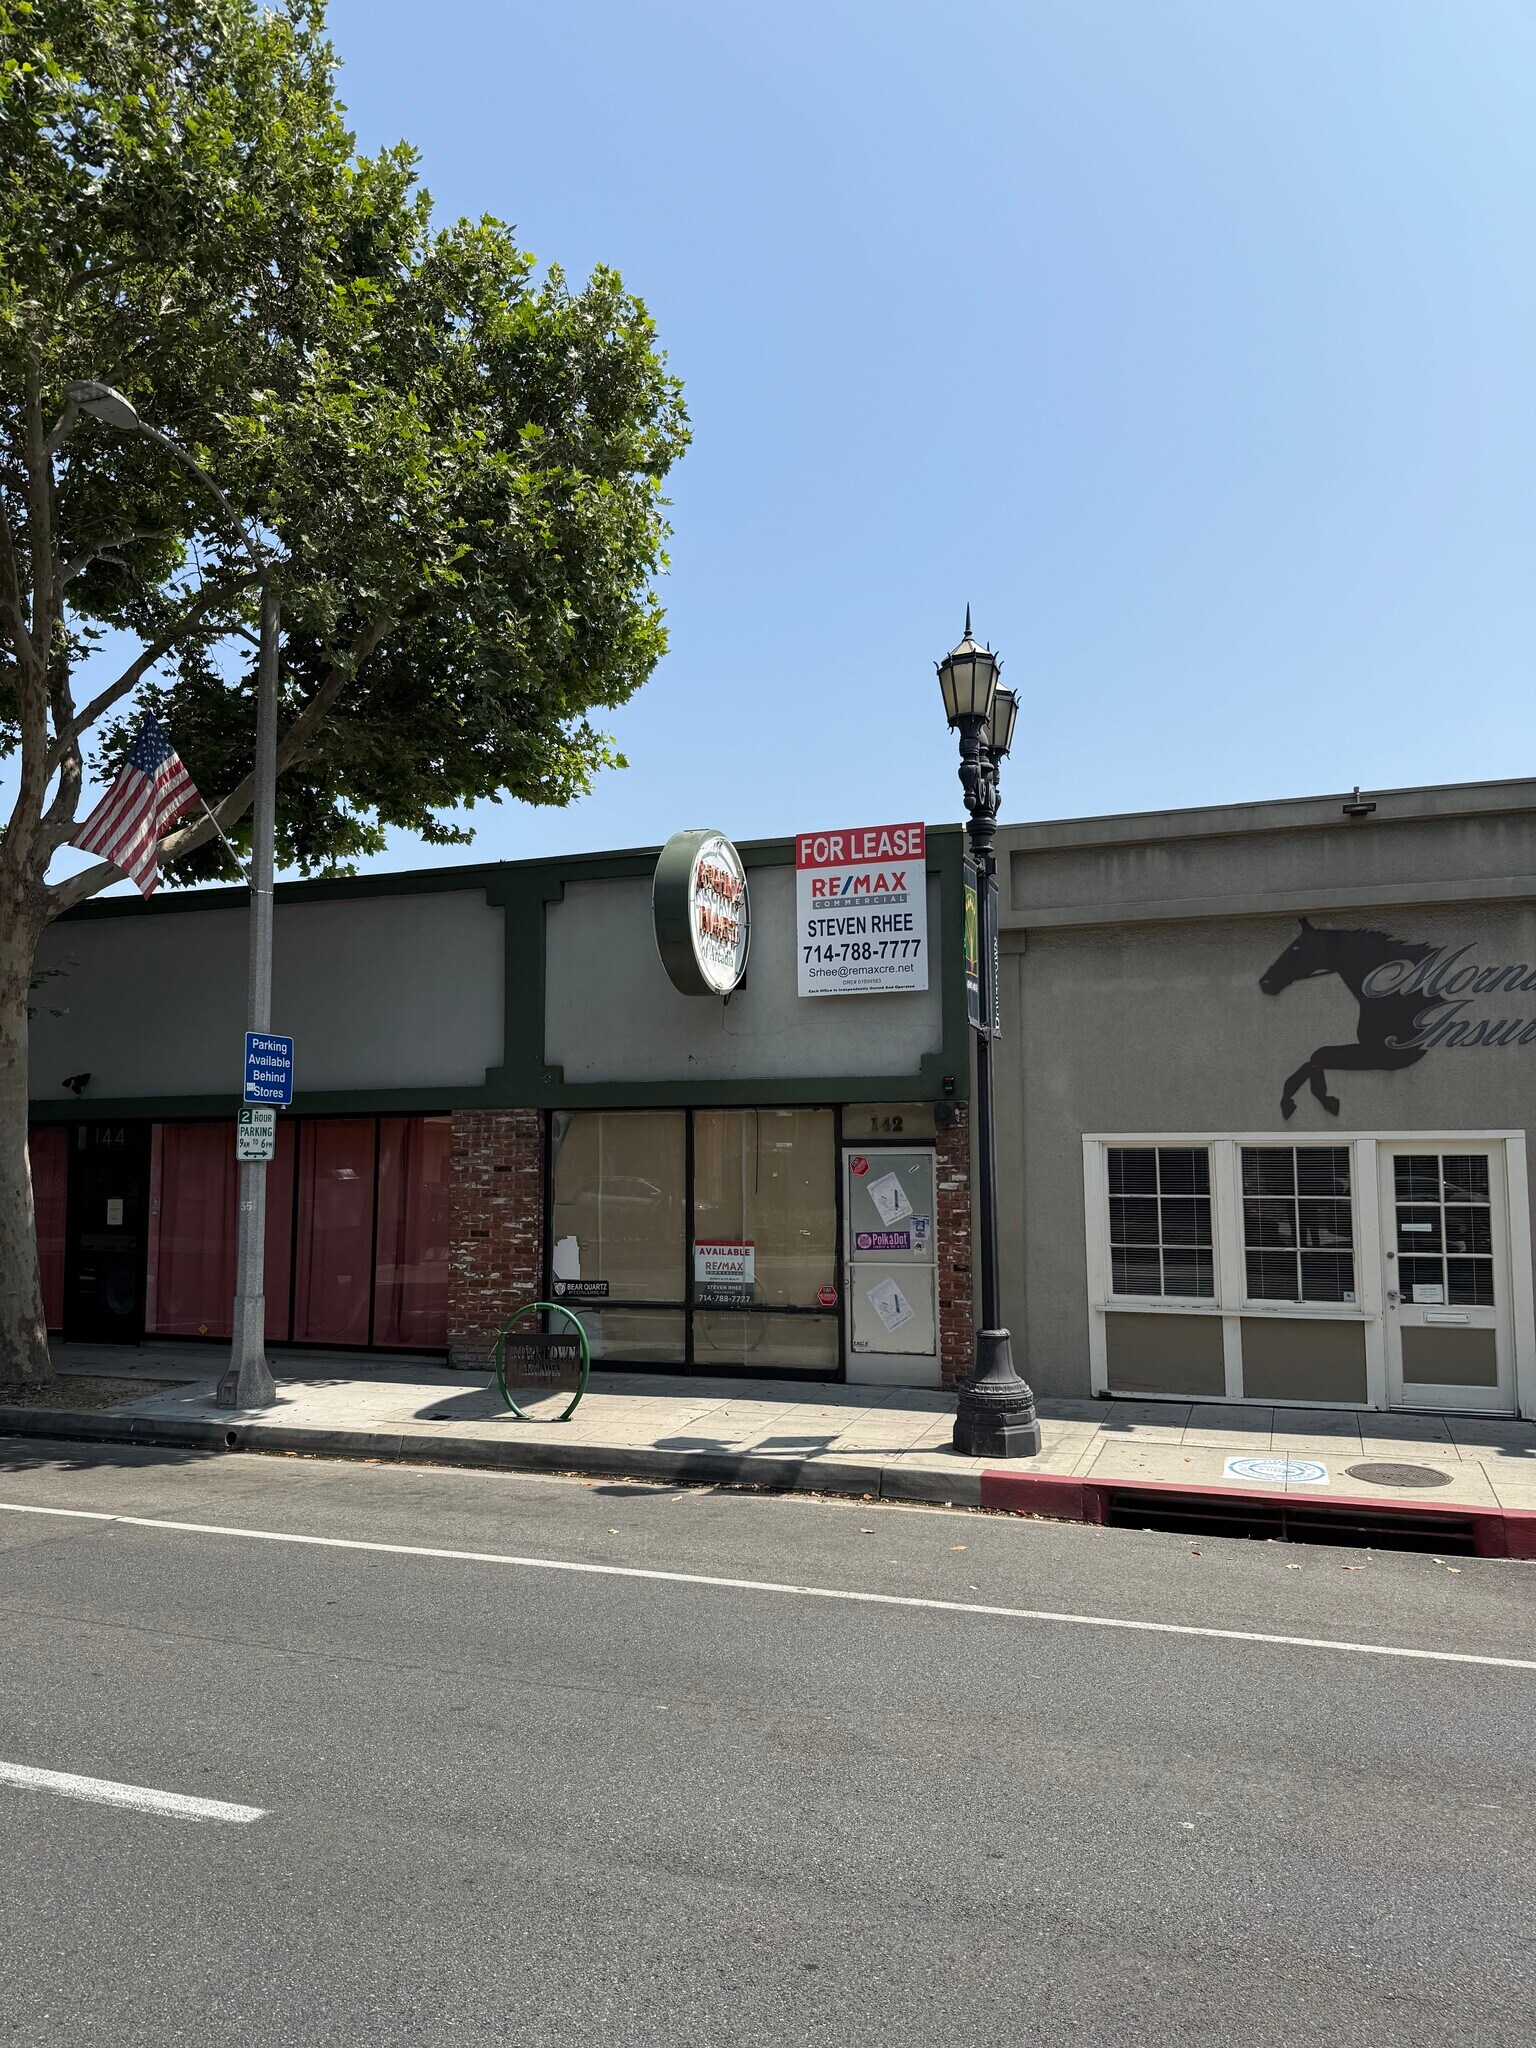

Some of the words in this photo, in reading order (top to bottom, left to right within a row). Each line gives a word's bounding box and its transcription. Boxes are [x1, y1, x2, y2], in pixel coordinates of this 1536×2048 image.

[801, 836, 845, 864] FOR
[851, 828, 922, 860] LEASE
[811, 871, 907, 898] RE/MAX
[815, 896, 905, 908] COMMERCIAL
[807, 916, 867, 937] STEVEN
[871, 913, 914, 933] RHEE
[710, 946, 734, 968] Arcadia
[803, 939, 922, 964] 714-788-7777
[809, 963, 915, 978] Srhee@remaxcre.net
[252, 1038, 288, 1055] Parking
[248, 1053, 291, 1068] Available
[253, 1069, 286, 1083] Behind
[253, 1085, 284, 1098] Stores
[241, 1111, 250, 1122] 2
[254, 1114, 272, 1123] HOUR
[870, 1116, 904, 1132] 142
[95, 1127, 125, 1148] 144
[240, 1126, 273, 1137] PARKING
[240, 1201, 253, 1212] 55
[699, 1247, 751, 1256] AVAILABLE
[705, 1261, 744, 1271] RE/MAX
[583, 1283, 607, 1291] QUARTZ
[699, 1294, 751, 1303] 714-788-7777
[509, 1345, 577, 1360] DOWNTOWN
